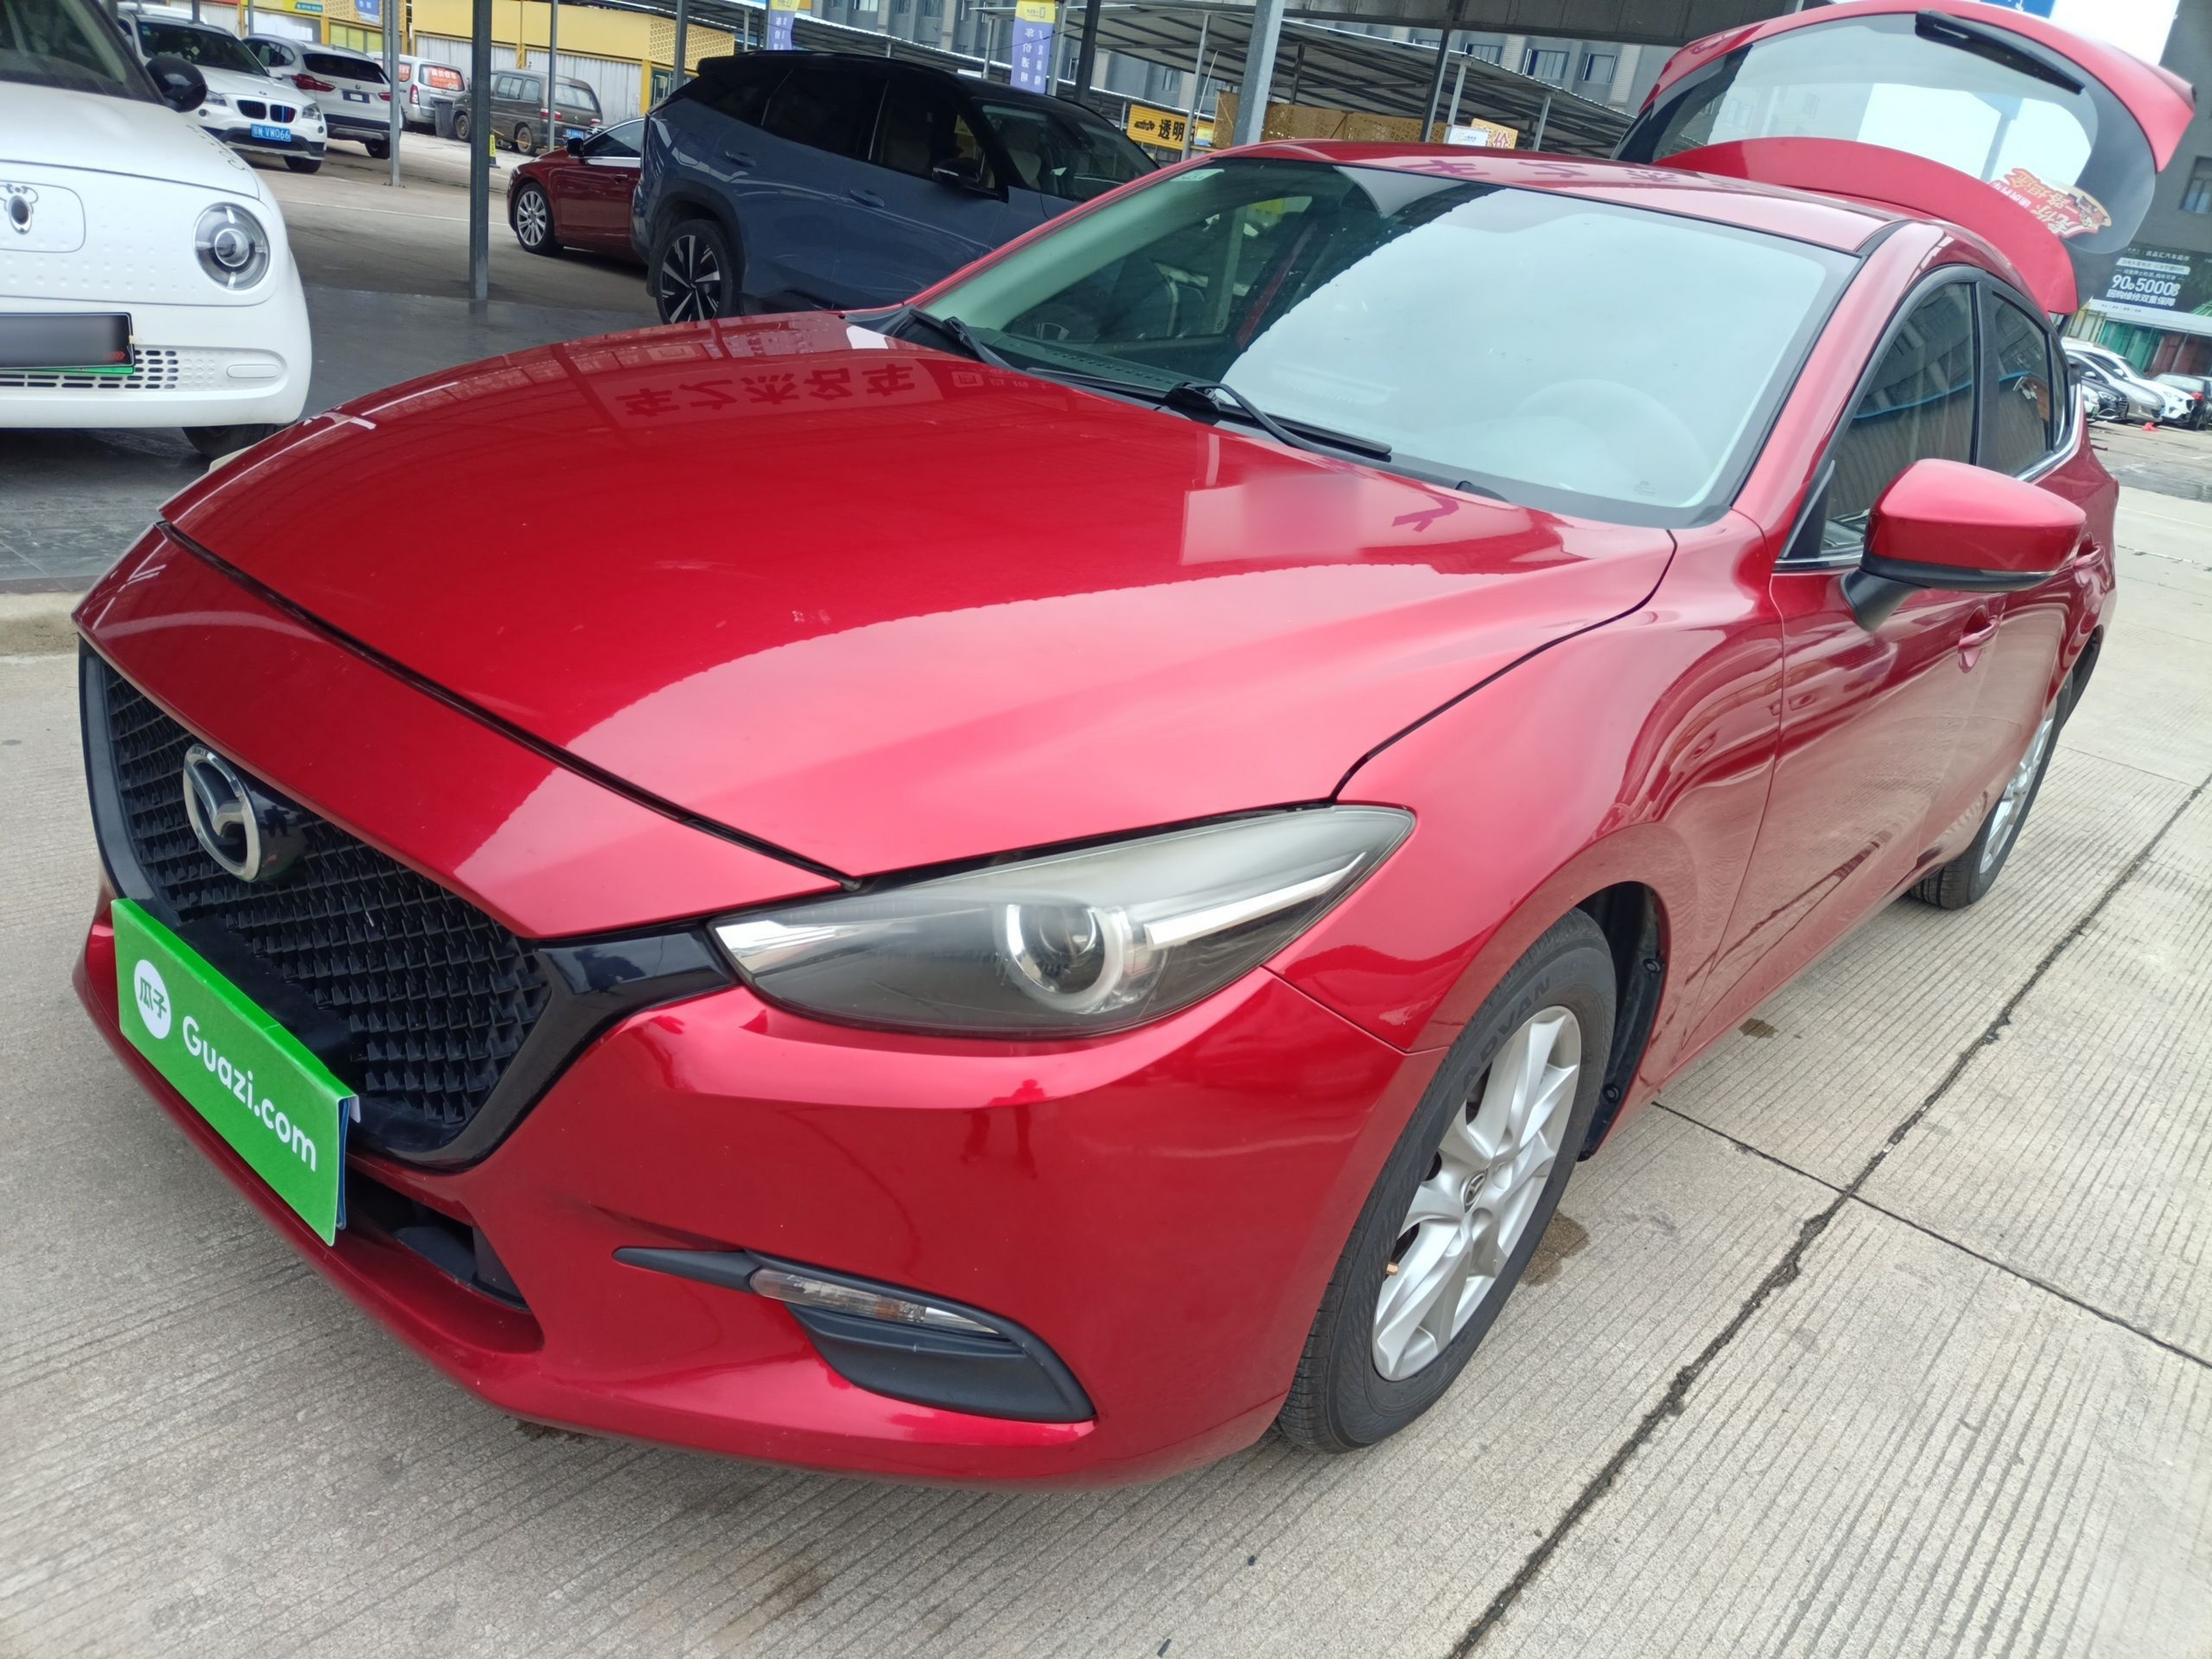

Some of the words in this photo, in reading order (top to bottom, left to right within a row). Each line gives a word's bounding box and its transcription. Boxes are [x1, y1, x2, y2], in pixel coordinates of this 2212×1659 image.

[139, 976, 167, 1020] 瓜子
[1460, 976, 1551, 1096] ADVAN
[183, 1016, 316, 1172] Guazi.com
